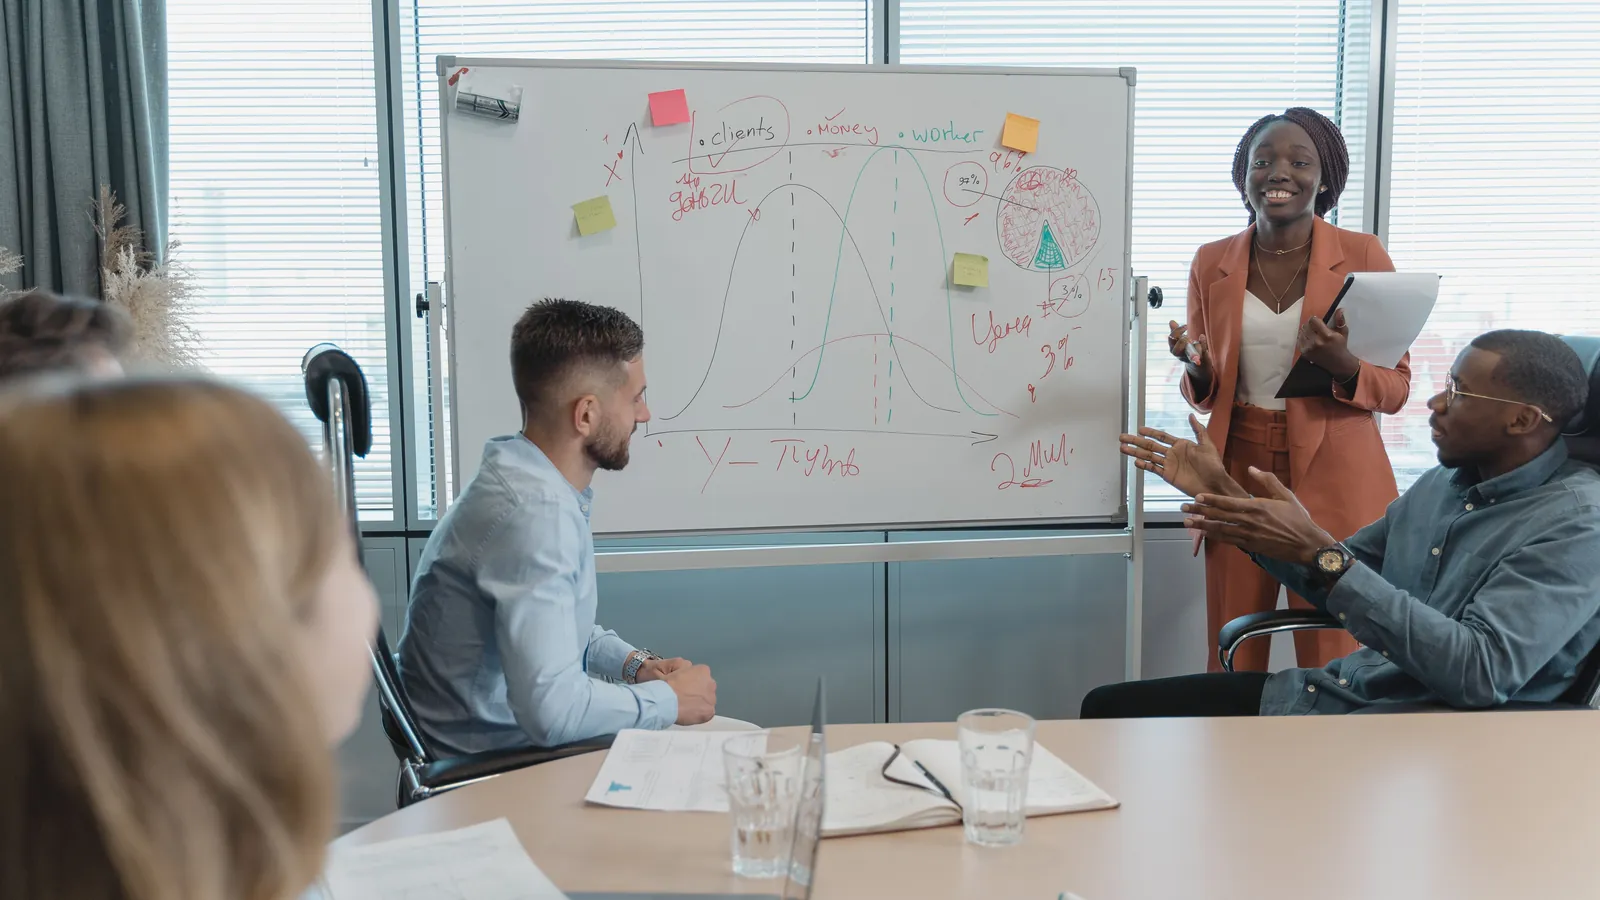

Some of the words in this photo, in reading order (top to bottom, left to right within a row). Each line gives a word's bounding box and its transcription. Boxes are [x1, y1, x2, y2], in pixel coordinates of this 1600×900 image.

[711, 116, 775, 147] clients
[911, 120, 984, 143] worker
[958, 173, 980, 186] 97%
